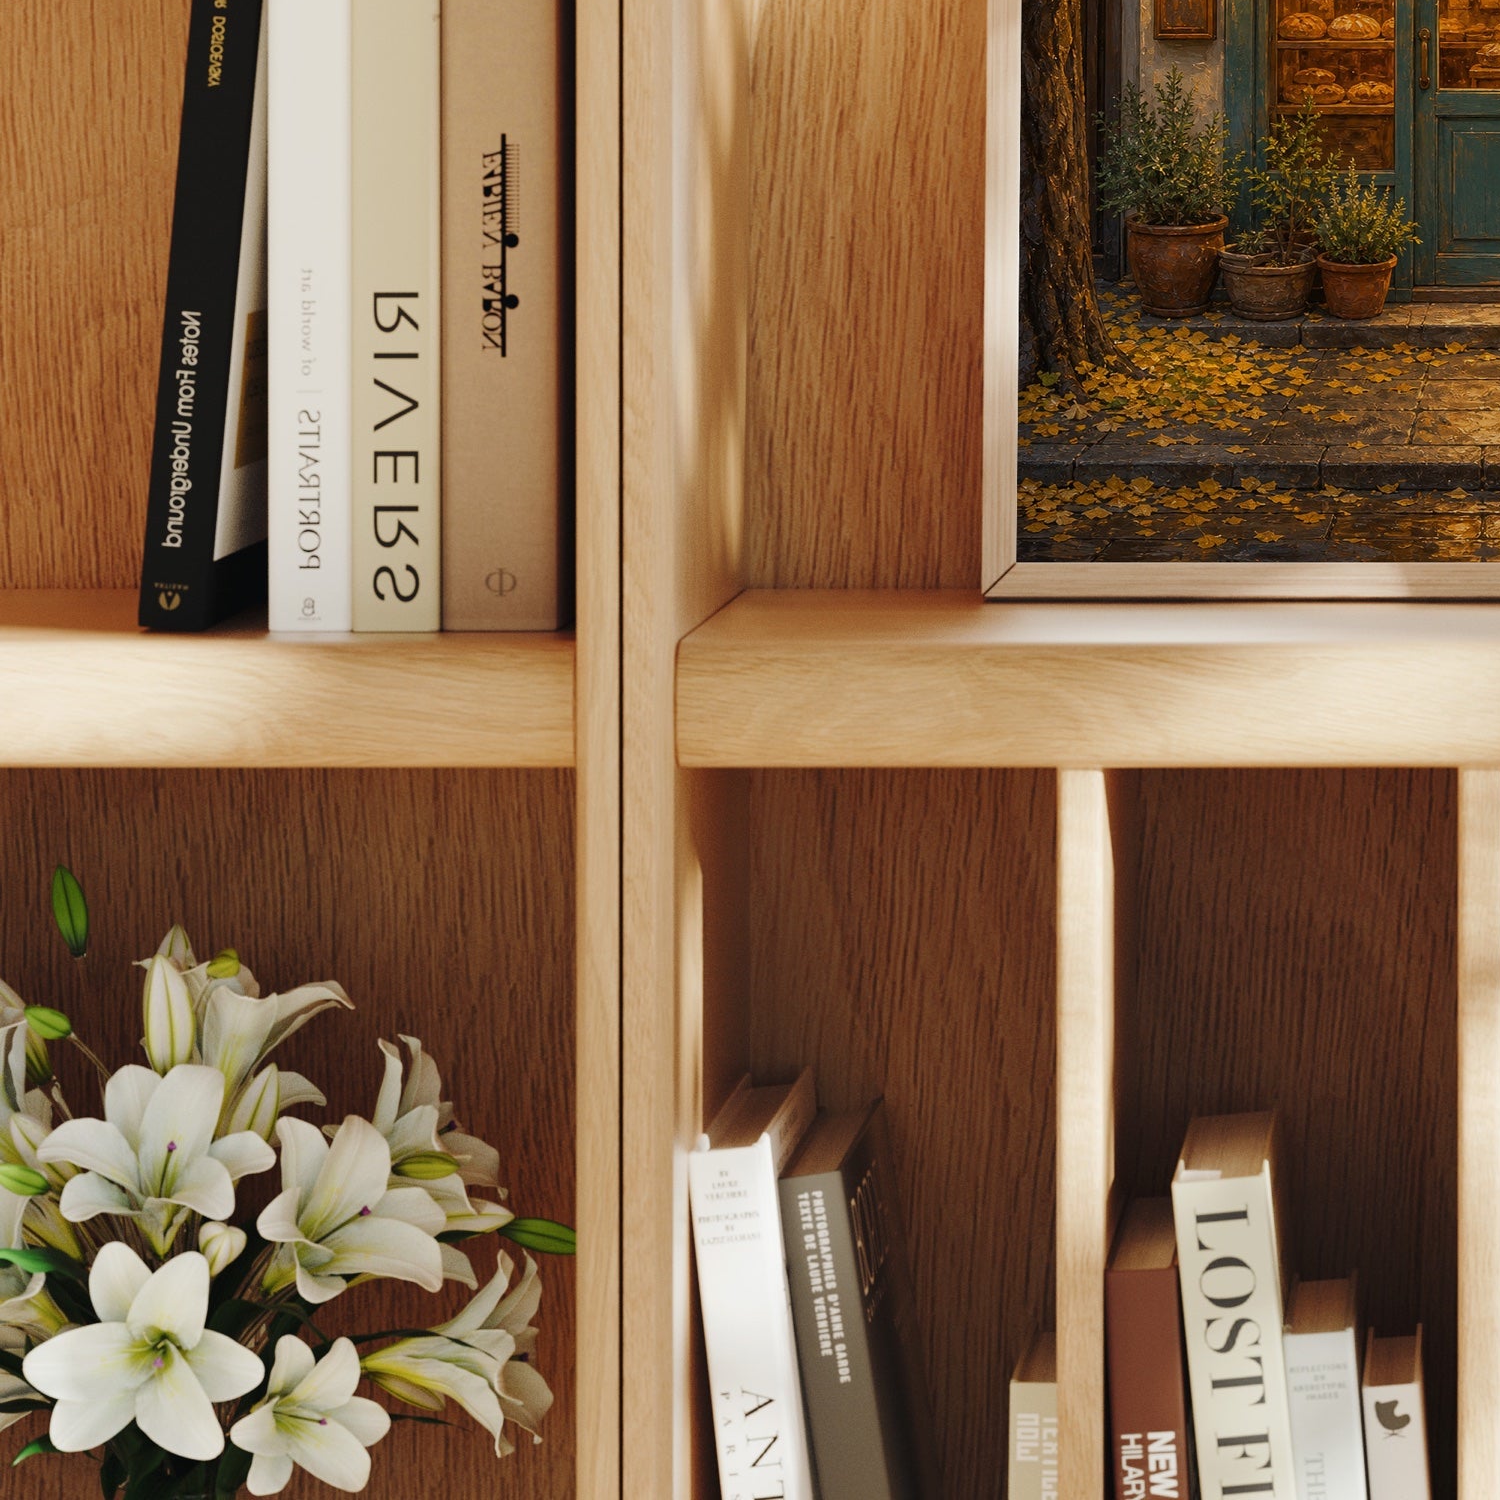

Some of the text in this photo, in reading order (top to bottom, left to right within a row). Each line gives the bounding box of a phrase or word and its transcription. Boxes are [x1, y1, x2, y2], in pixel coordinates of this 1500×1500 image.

[797, 1191, 814, 1230] TEXTE
[803, 1233, 818, 1250] DE
[806, 1254, 823, 1294] LAURE
[811, 1190, 852, 1384] PHOTOGRAPHIES D'ANNE GARDE
[1194, 1204, 1266, 1406] LOST
[1147, 1431, 1179, 1498] NEW
